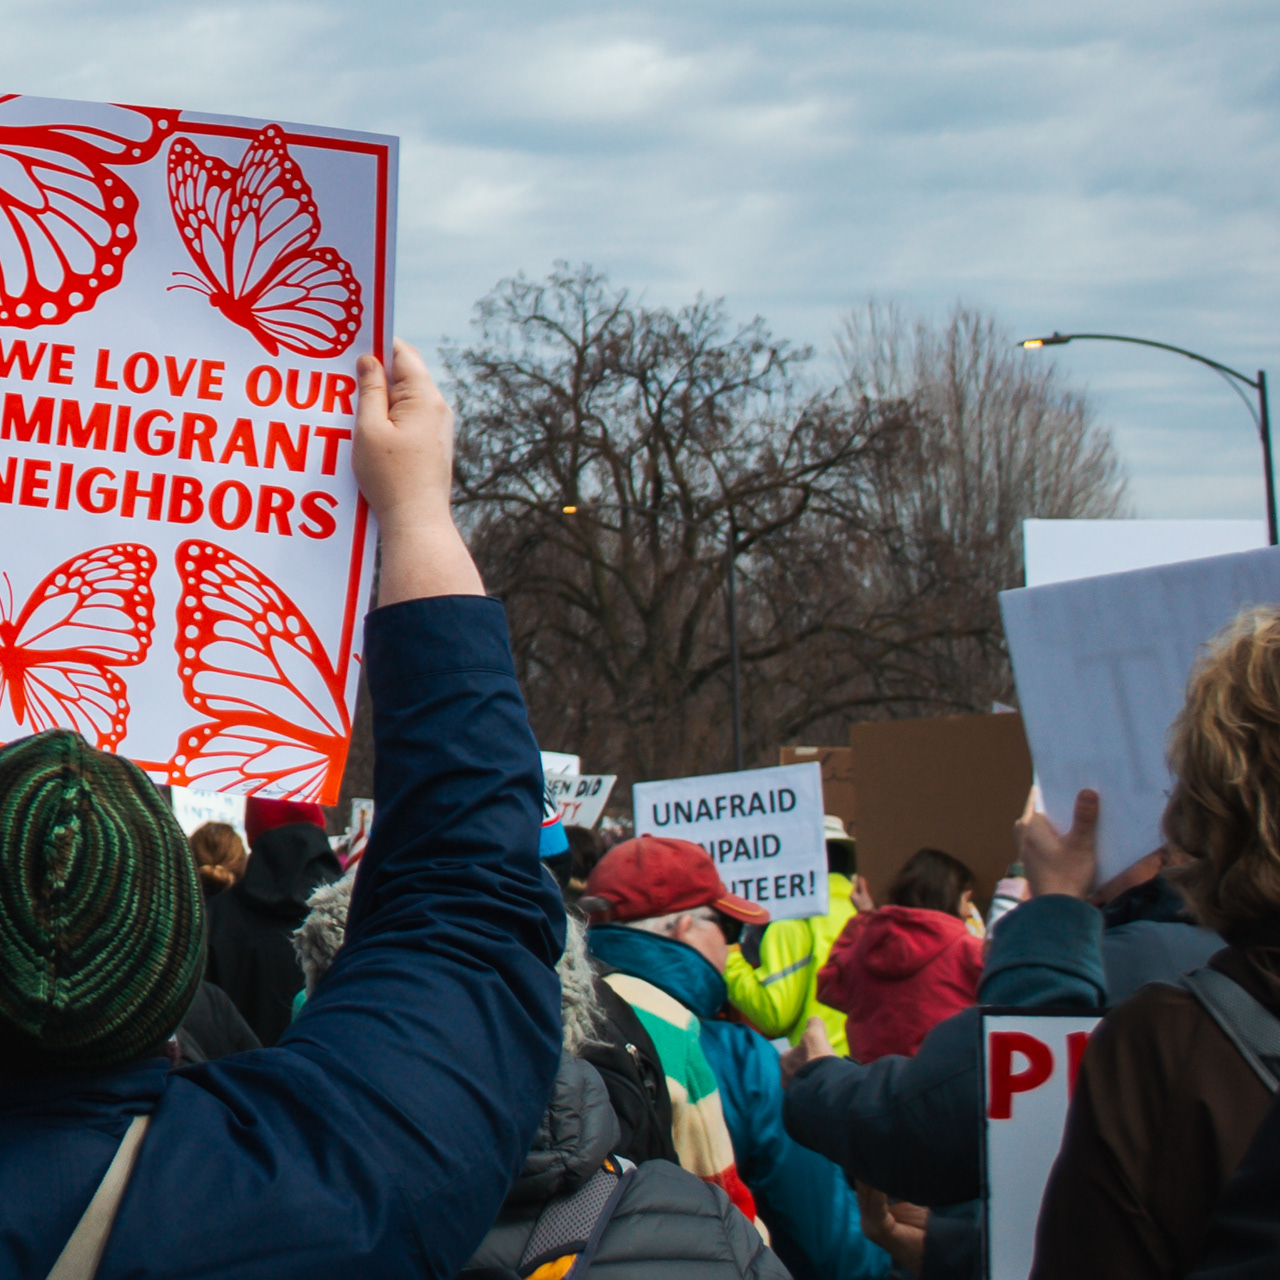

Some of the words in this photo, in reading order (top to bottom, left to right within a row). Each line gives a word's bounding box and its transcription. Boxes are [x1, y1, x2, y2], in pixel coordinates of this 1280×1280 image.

[94, 348, 225, 401] LOVE
[245, 364, 357, 415] OUR
[575, 777, 602, 798] DID
[653, 788, 797, 827] UNAFRAID
[698, 834, 781, 863] PAID
